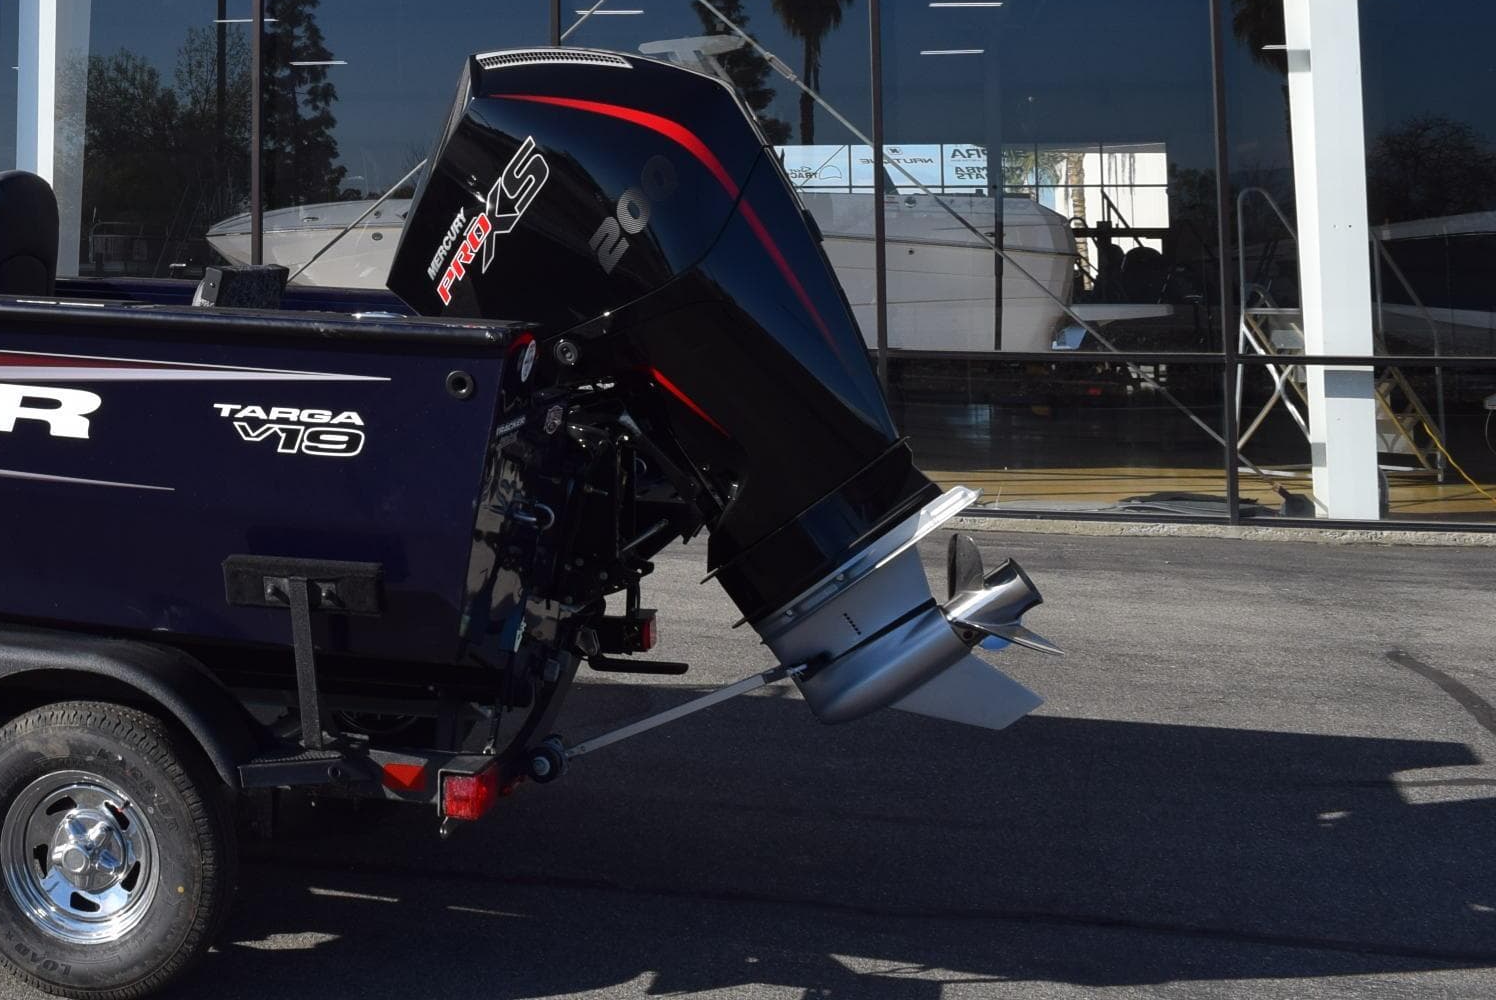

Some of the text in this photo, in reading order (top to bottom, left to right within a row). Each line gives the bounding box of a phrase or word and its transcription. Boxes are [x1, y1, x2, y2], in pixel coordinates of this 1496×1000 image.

[427, 207, 467, 281] MERCURY
[213, 403, 365, 426] TARGA
[233, 421, 365, 457] V19
